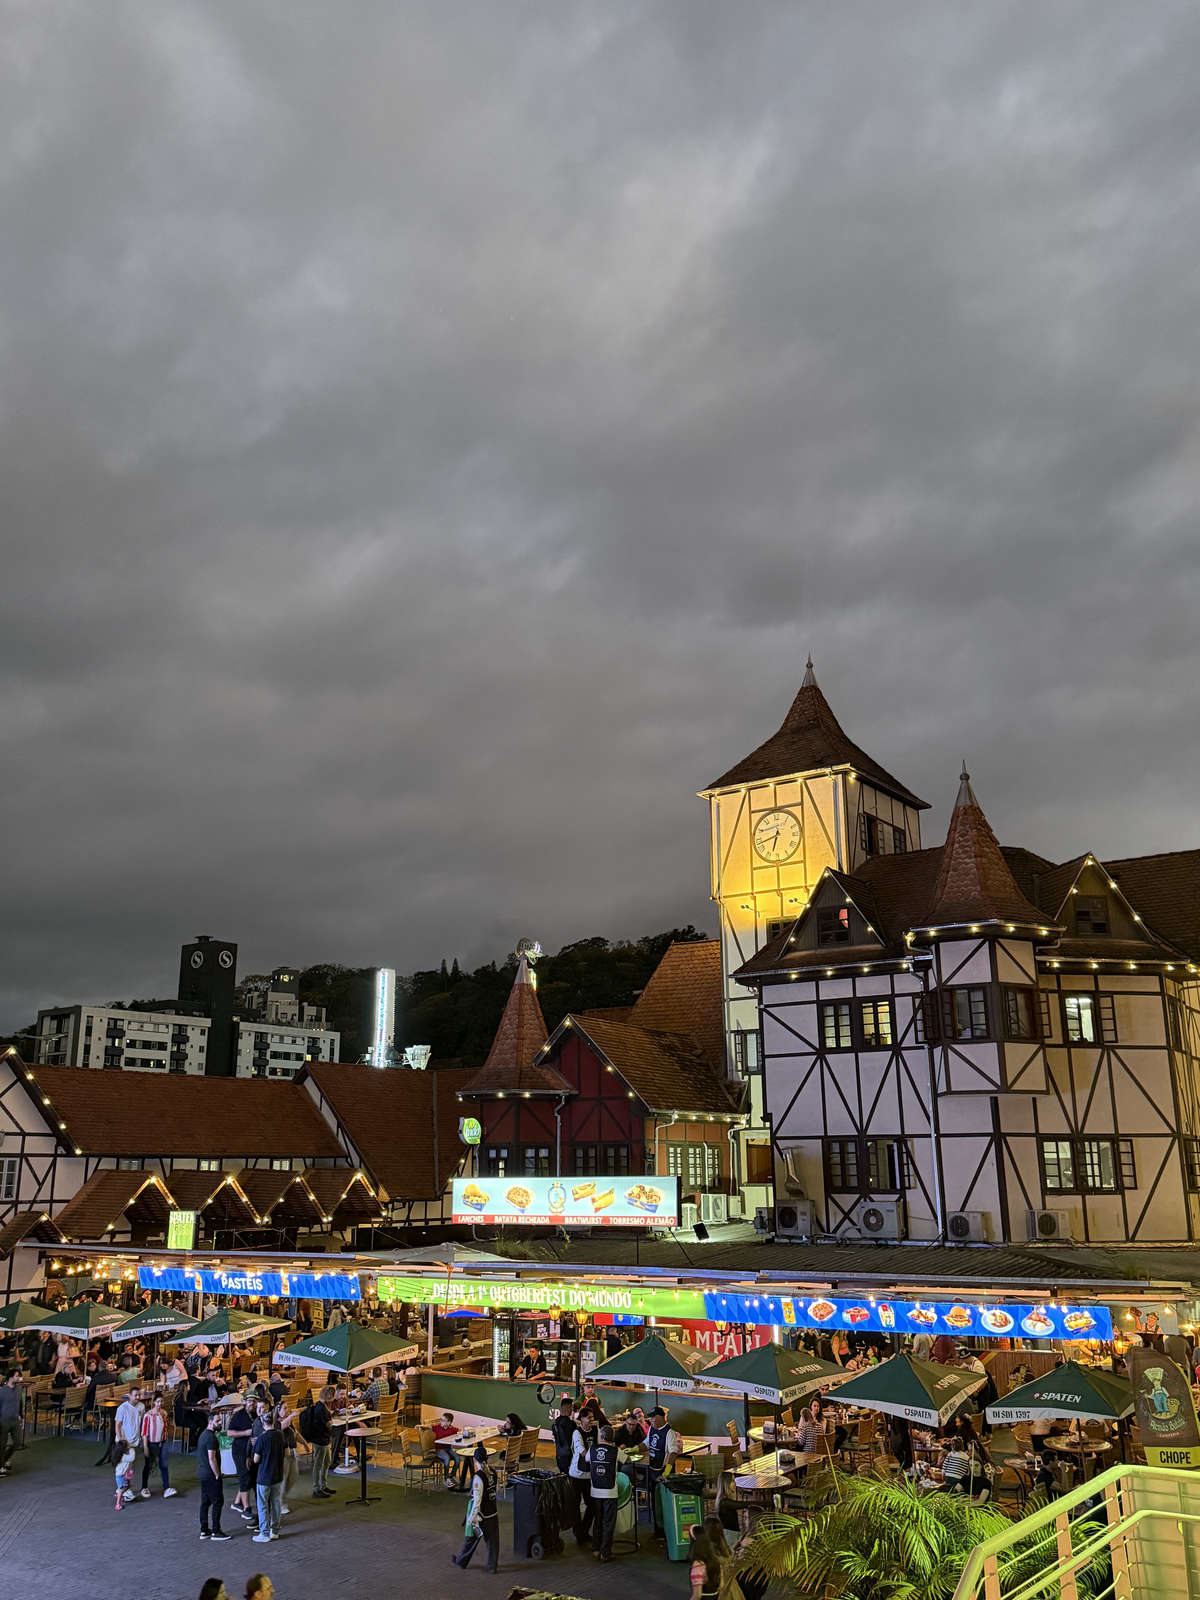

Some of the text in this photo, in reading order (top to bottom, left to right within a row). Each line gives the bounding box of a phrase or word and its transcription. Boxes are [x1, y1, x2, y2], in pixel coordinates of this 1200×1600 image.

[458, 1215, 485, 1224] LANCHES
[494, 1215, 550, 1224] BATATA RECHEADA
[564, 1216, 602, 1225] BRATWURST
[609, 1215, 675, 1225] TORRESMO ALEMÃO
[569, 1289, 586, 1306] DO
[311, 1344, 338, 1358] SPATEN
[667, 1379, 688, 1388] SPATEN
[1040, 1392, 1082, 1403] SPATEN
[910, 1408, 932, 1420] SPATEN
[1159, 1450, 1192, 1465] CHOPE
